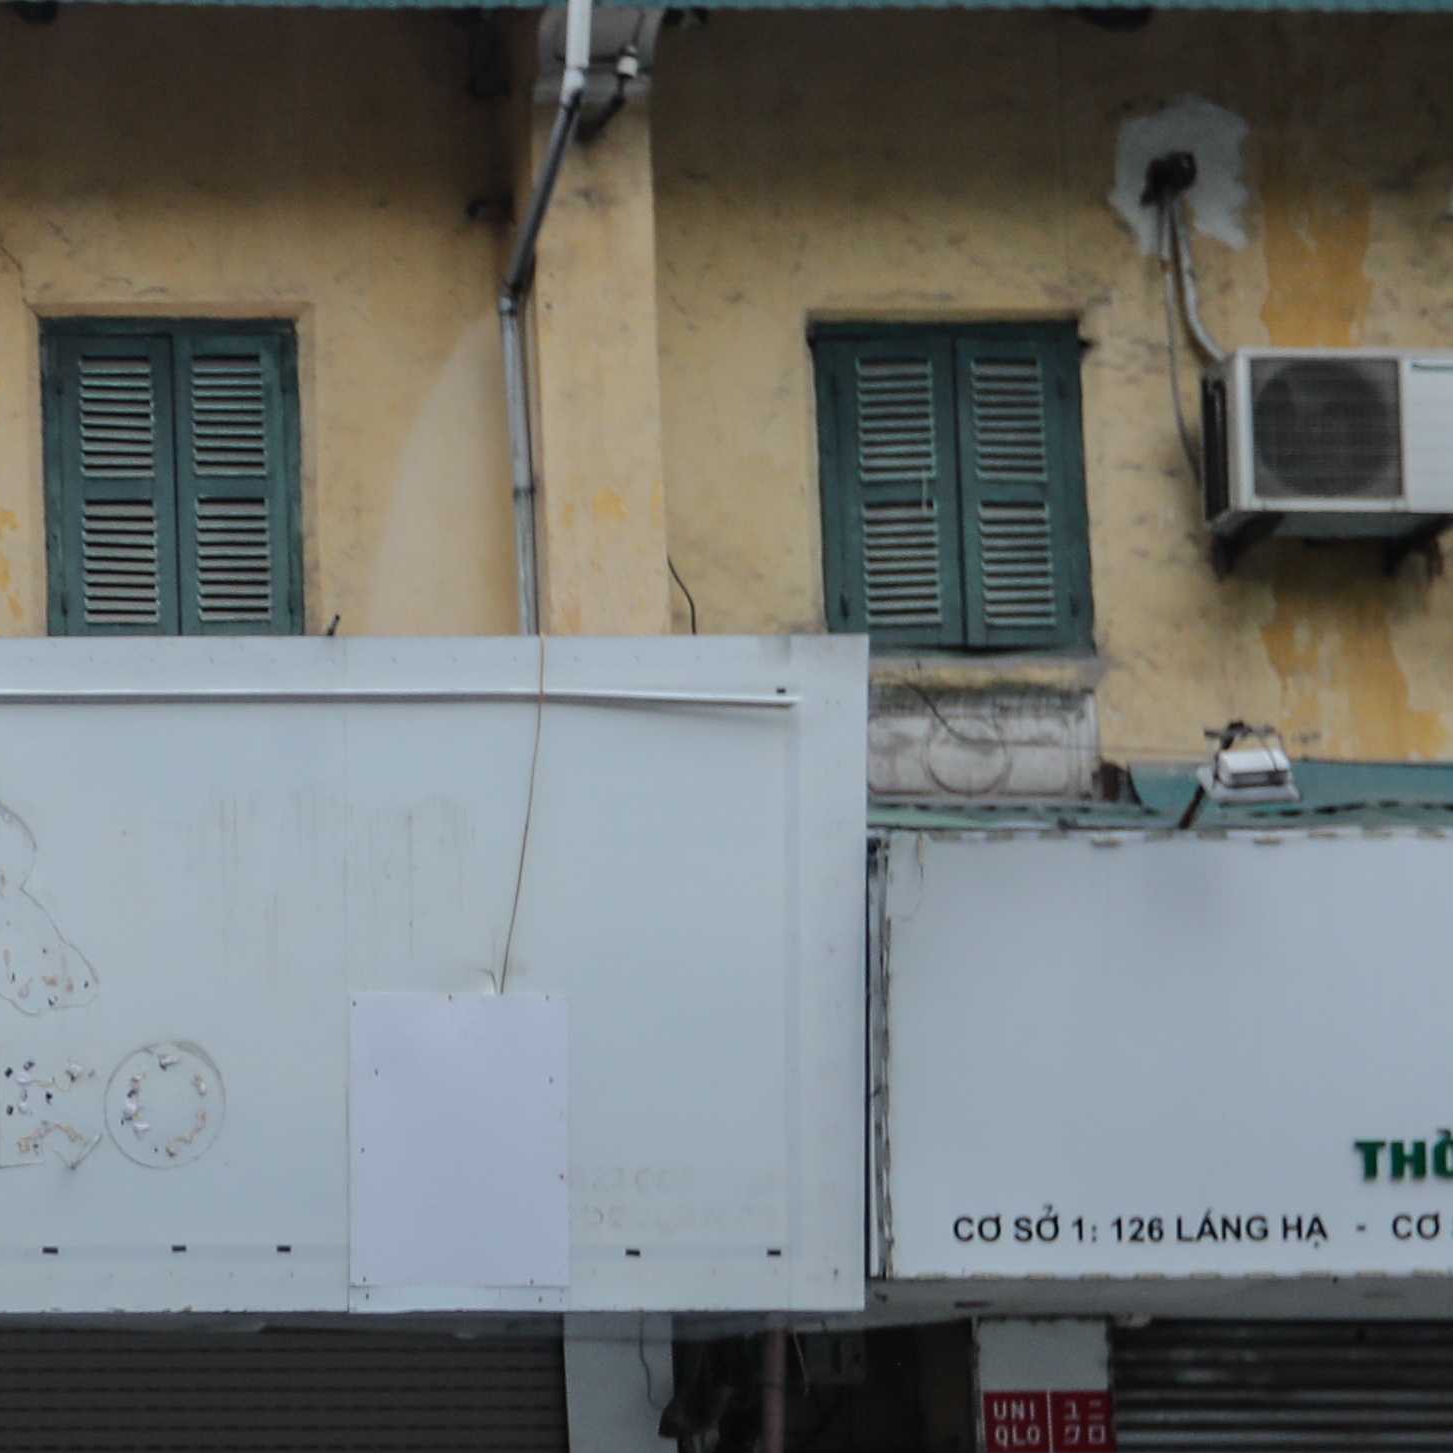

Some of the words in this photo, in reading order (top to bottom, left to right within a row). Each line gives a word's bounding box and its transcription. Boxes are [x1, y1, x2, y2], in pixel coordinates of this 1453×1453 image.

[952, 1214, 1002, 1243] CƠ
[1012, 1204, 1060, 1243] SỞ
[1110, 1215, 1165, 1243] 126
[1175, 1207, 1270, 1243] LÁNG
[1282, 1214, 1330, 1249] HẠ
[1391, 1210, 1441, 1241] CƠ
[993, 1399, 1036, 1421] UNI
[995, 1424, 1040, 1449] QLO
